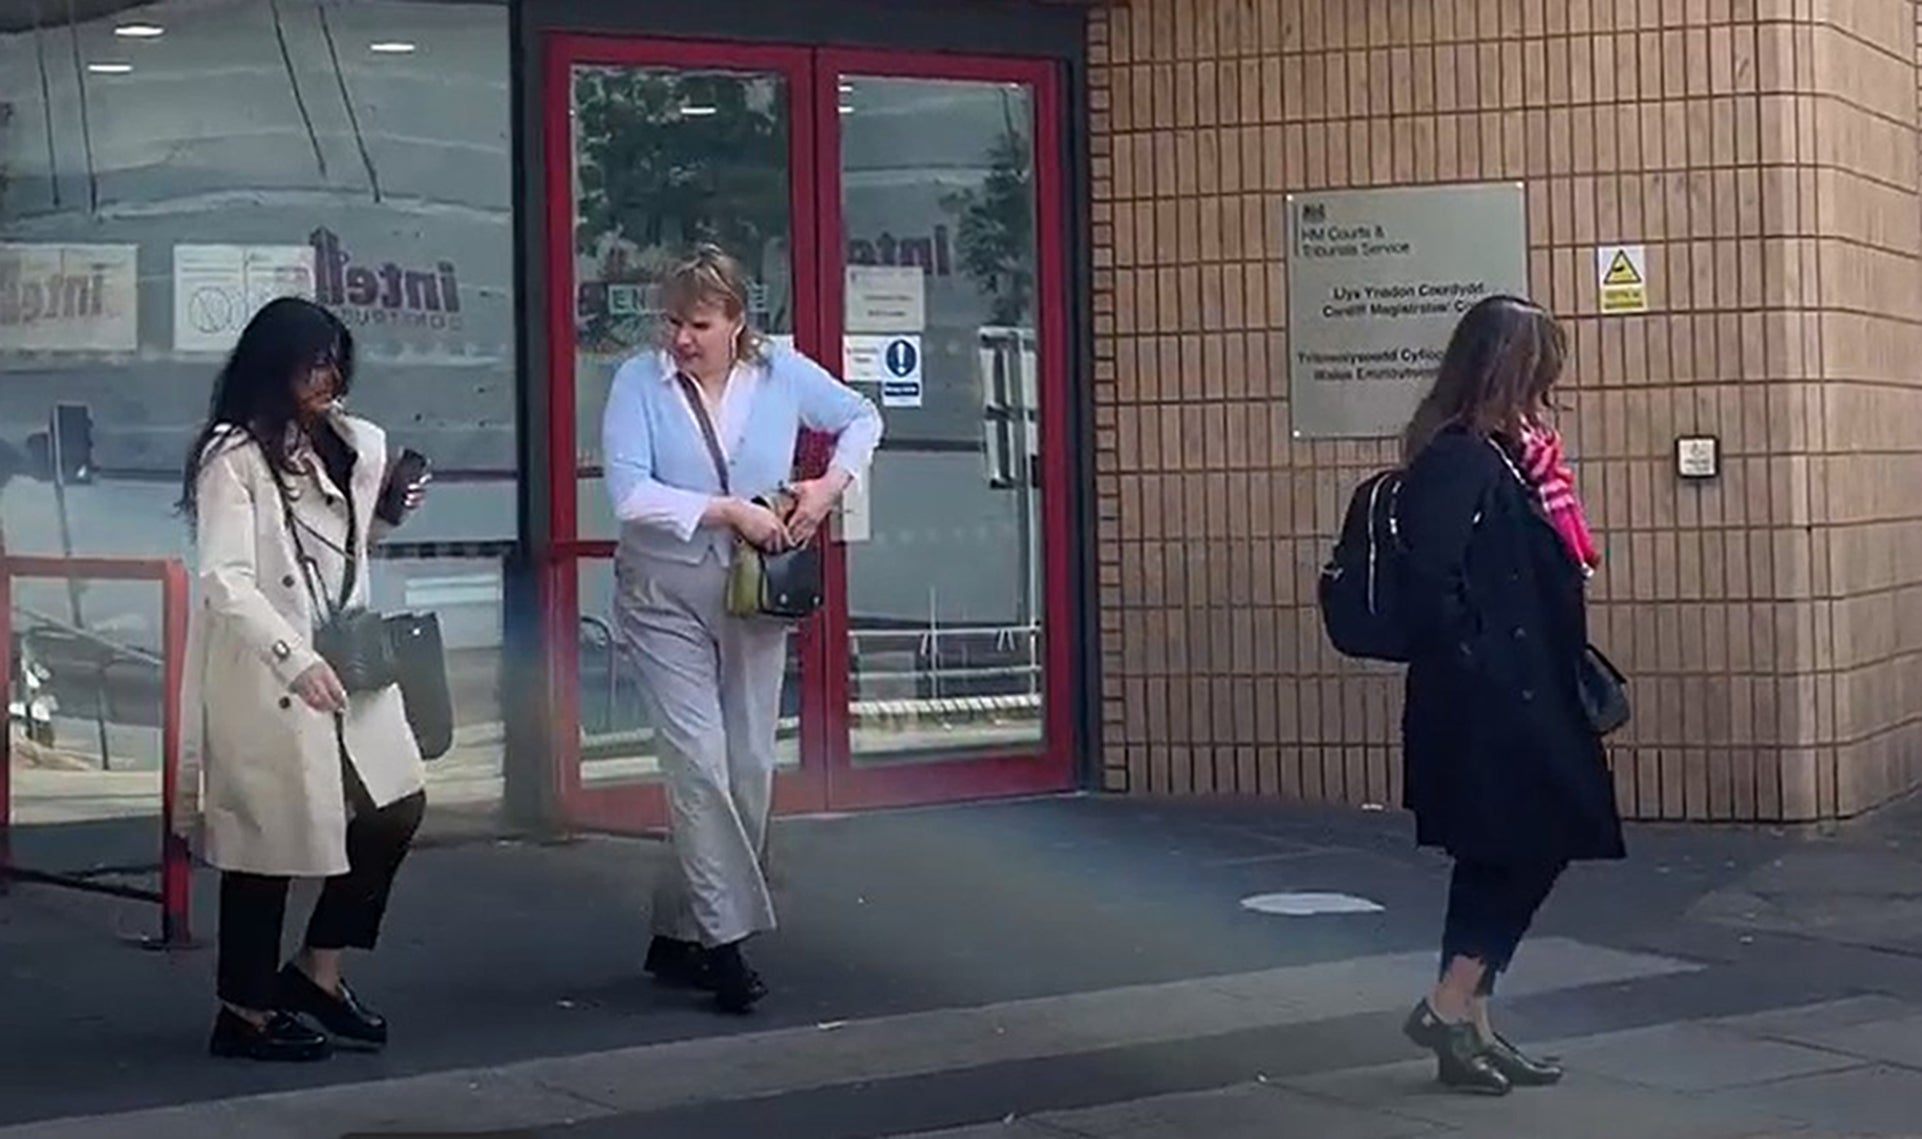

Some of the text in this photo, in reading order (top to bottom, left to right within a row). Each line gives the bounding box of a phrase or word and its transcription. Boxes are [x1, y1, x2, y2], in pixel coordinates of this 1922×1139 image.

[1302, 228, 1324, 241] HM
[1328, 226, 1371, 241] Courts
[1303, 242, 1410, 258] Tribunals Service
[1323, 304, 1366, 318] Cardiff
